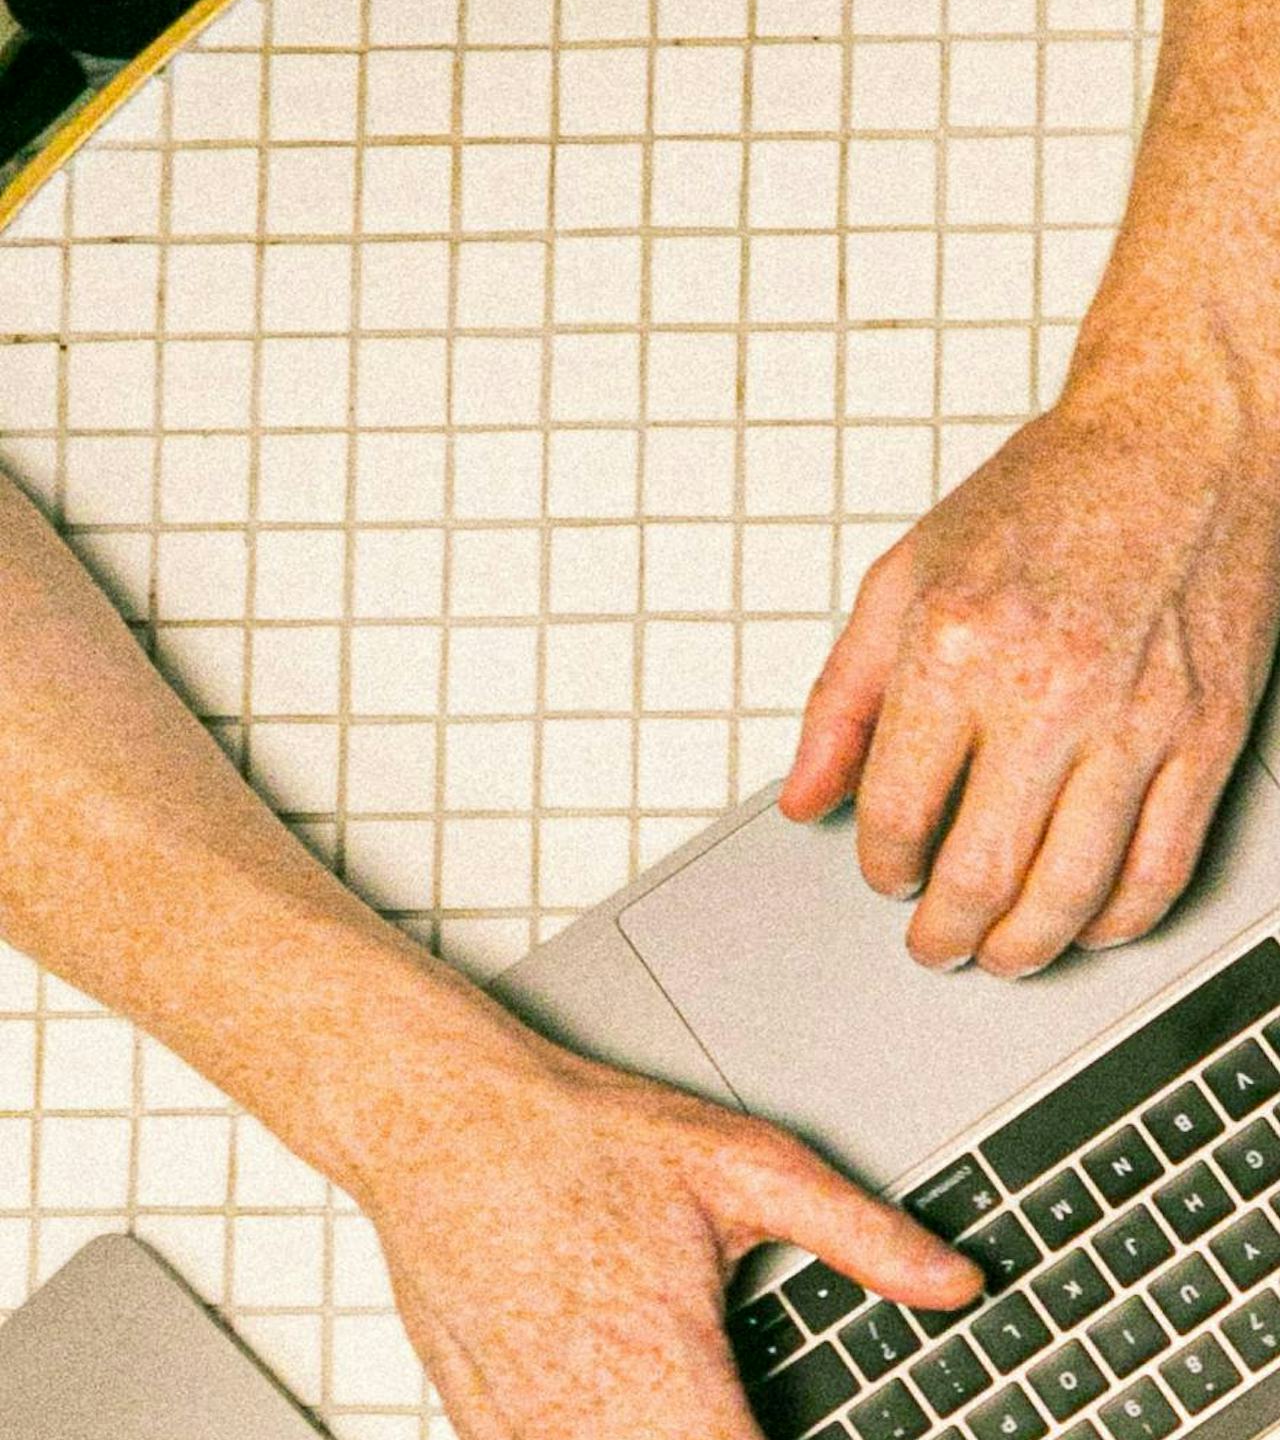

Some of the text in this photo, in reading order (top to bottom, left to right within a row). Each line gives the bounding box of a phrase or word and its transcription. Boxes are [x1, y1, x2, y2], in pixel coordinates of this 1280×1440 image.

[1235, 1071, 1254, 1090] V
[1173, 1112, 1194, 1132] B
[1111, 1156, 1133, 1177] N
[1244, 1149, 1264, 1169] G
[1049, 1199, 1073, 1221] M
[1183, 1192, 1204, 1213] H
[1124, 1236, 1138, 1256] J
[1243, 1242, 1261, 1260] Y
[1062, 1279, 1083, 1299] K
[1179, 1283, 1200, 1304] U
[1002, 1323, 1021, 1339] L
[1249, 1312, 1264, 1331] 7
[1184, 1354, 1203, 1374] 8
[1057, 1370, 1078, 1391] O
[1123, 1398, 1142, 1417] 9
[1000, 1414, 1018, 1434] P
